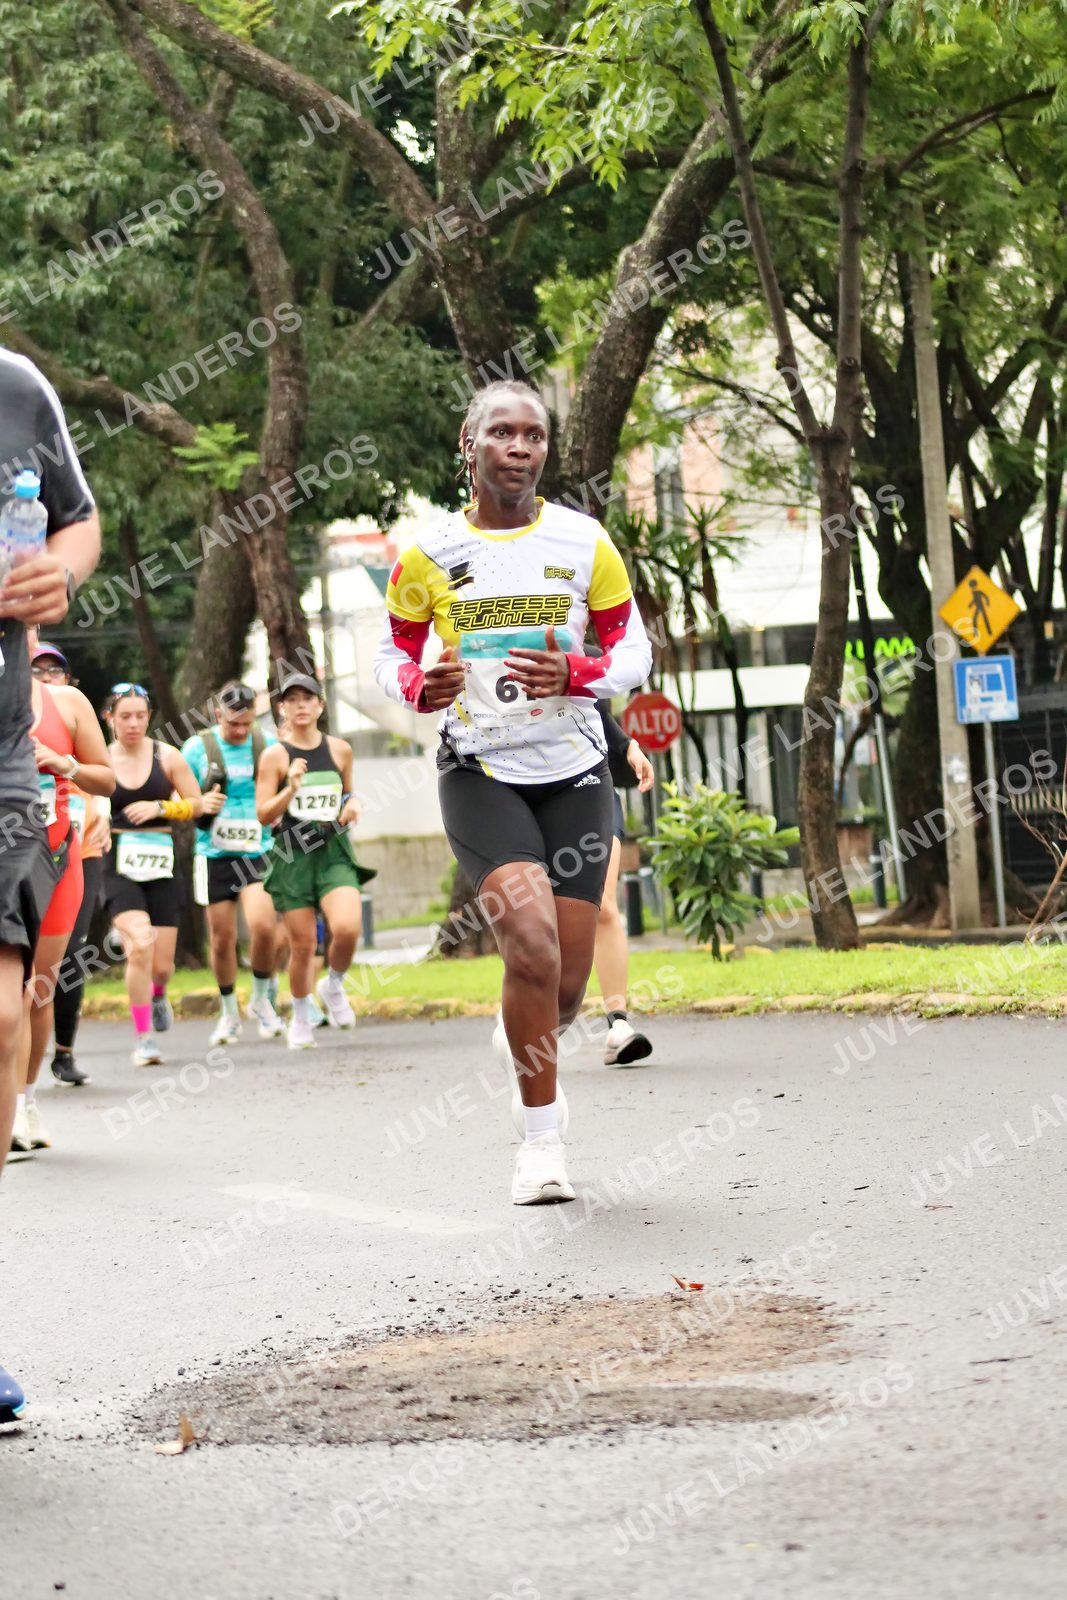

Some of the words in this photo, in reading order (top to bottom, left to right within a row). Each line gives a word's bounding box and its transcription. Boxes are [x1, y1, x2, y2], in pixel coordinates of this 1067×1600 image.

[448, 594, 573, 618] ESPRESSO
[454, 610, 569, 632] RUNNERS
[628, 708, 678, 736] ALTO
[295, 794, 337, 810] 1278
[216, 826, 258, 841] 4592
[125, 853, 169, 869] 4772
